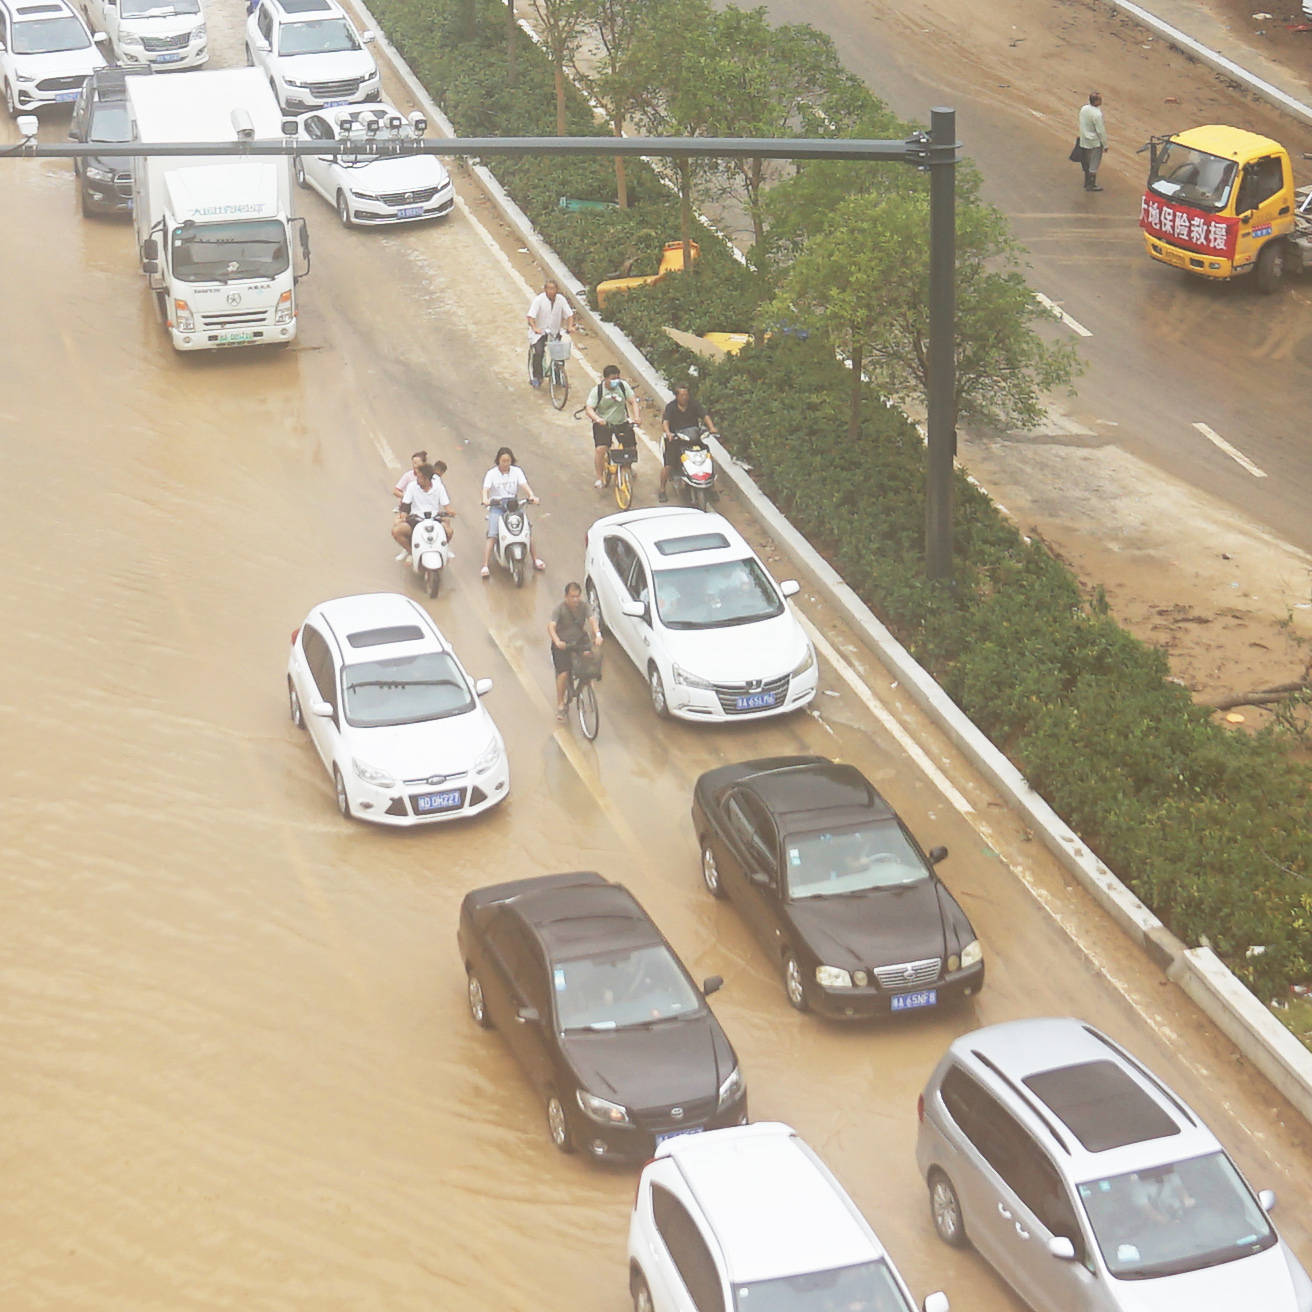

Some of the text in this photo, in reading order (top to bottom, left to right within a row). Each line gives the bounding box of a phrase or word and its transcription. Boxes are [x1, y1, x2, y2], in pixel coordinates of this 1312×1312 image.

[1139, 195, 1228, 251] 大地保险救援
